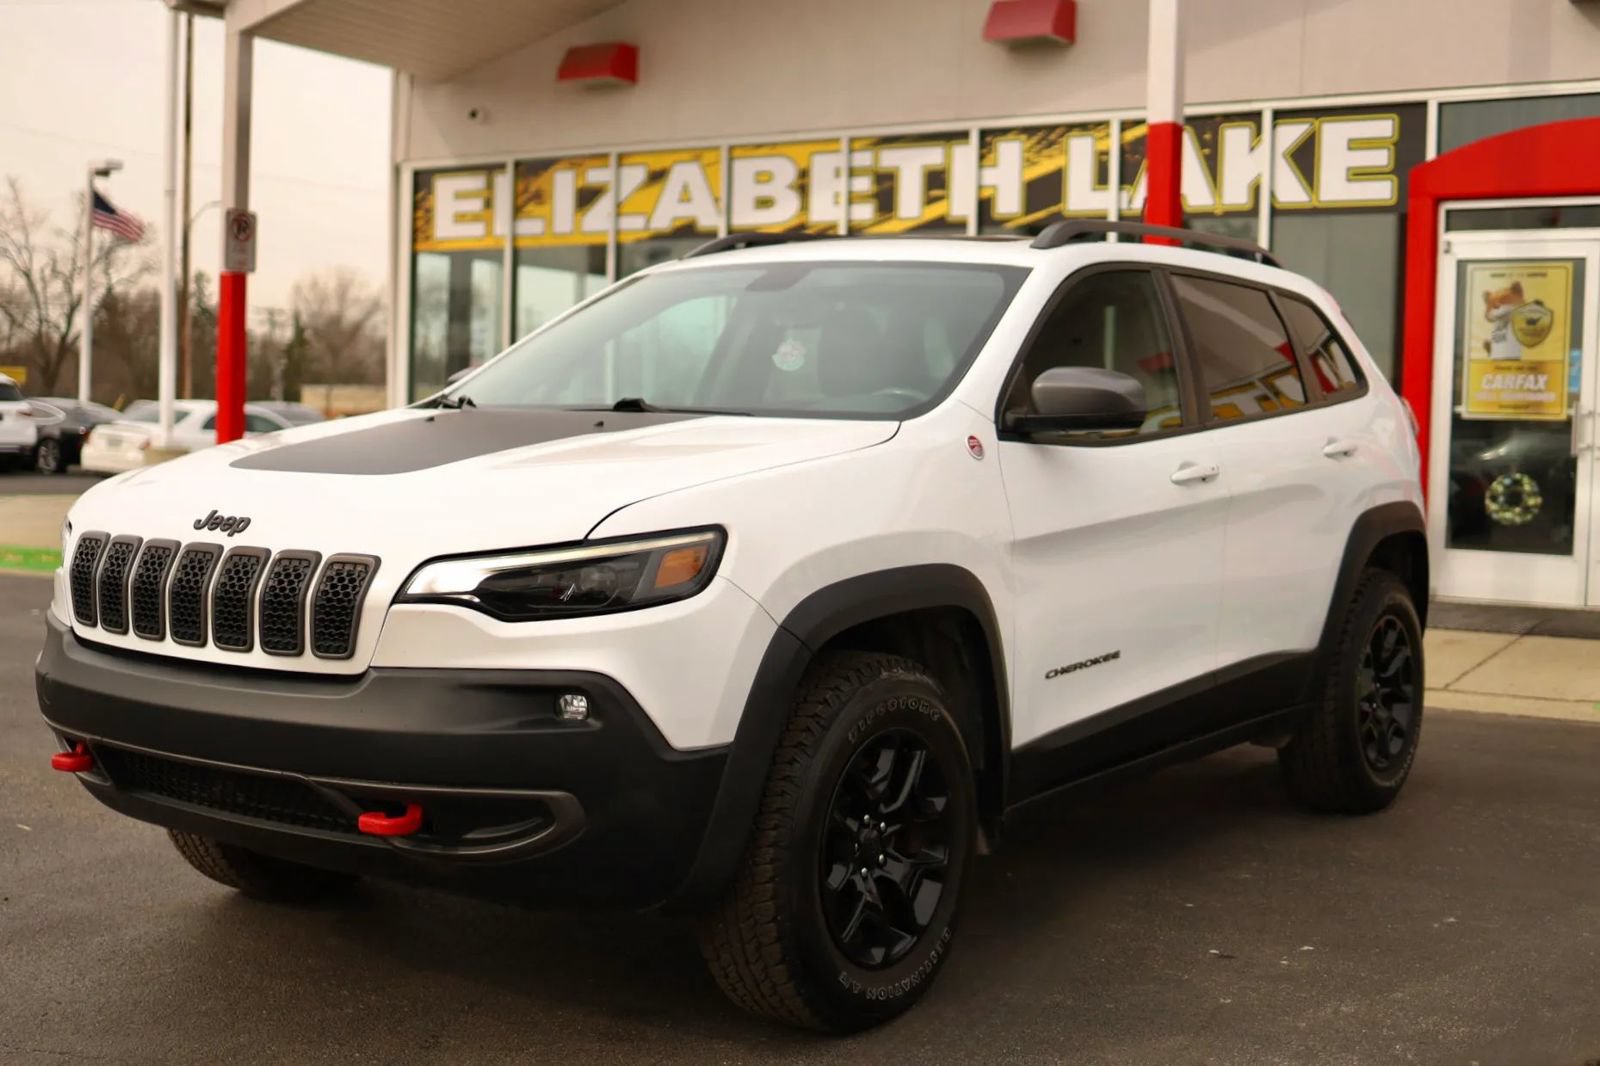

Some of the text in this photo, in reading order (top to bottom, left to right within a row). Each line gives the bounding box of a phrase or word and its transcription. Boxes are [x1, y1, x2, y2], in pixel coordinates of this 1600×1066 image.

[433, 114, 1399, 242] ELIZABETH LAKE
[1482, 374, 1548, 390] CARFAX
[193, 509, 252, 537] Jeep
[1045, 650, 1120, 679] CHEROKEE
[865, 926, 952, 1001] DESTINATION
